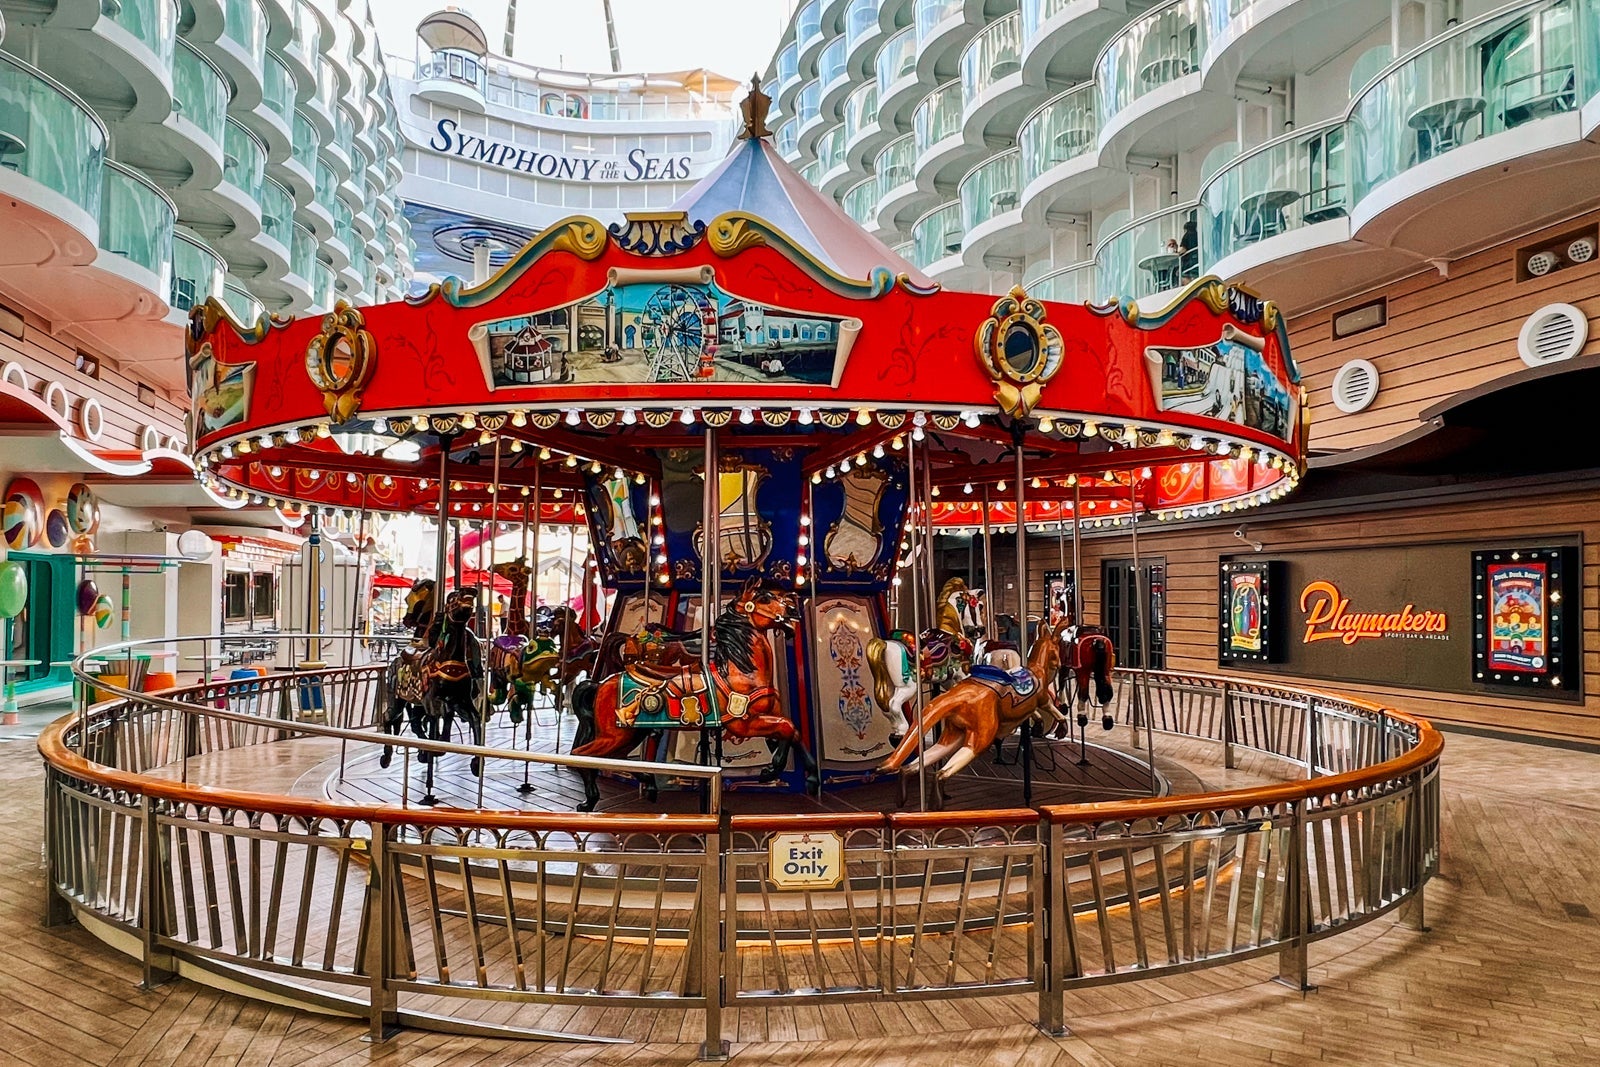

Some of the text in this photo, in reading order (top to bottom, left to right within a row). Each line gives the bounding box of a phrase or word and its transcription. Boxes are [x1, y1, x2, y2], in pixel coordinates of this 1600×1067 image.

[430, 118, 691, 181] SYMPHONY OF THE SEAS
[1300, 580, 1446, 645] Playmakers
[783, 860, 828, 878] Only
[789, 846, 823, 860] Exit
